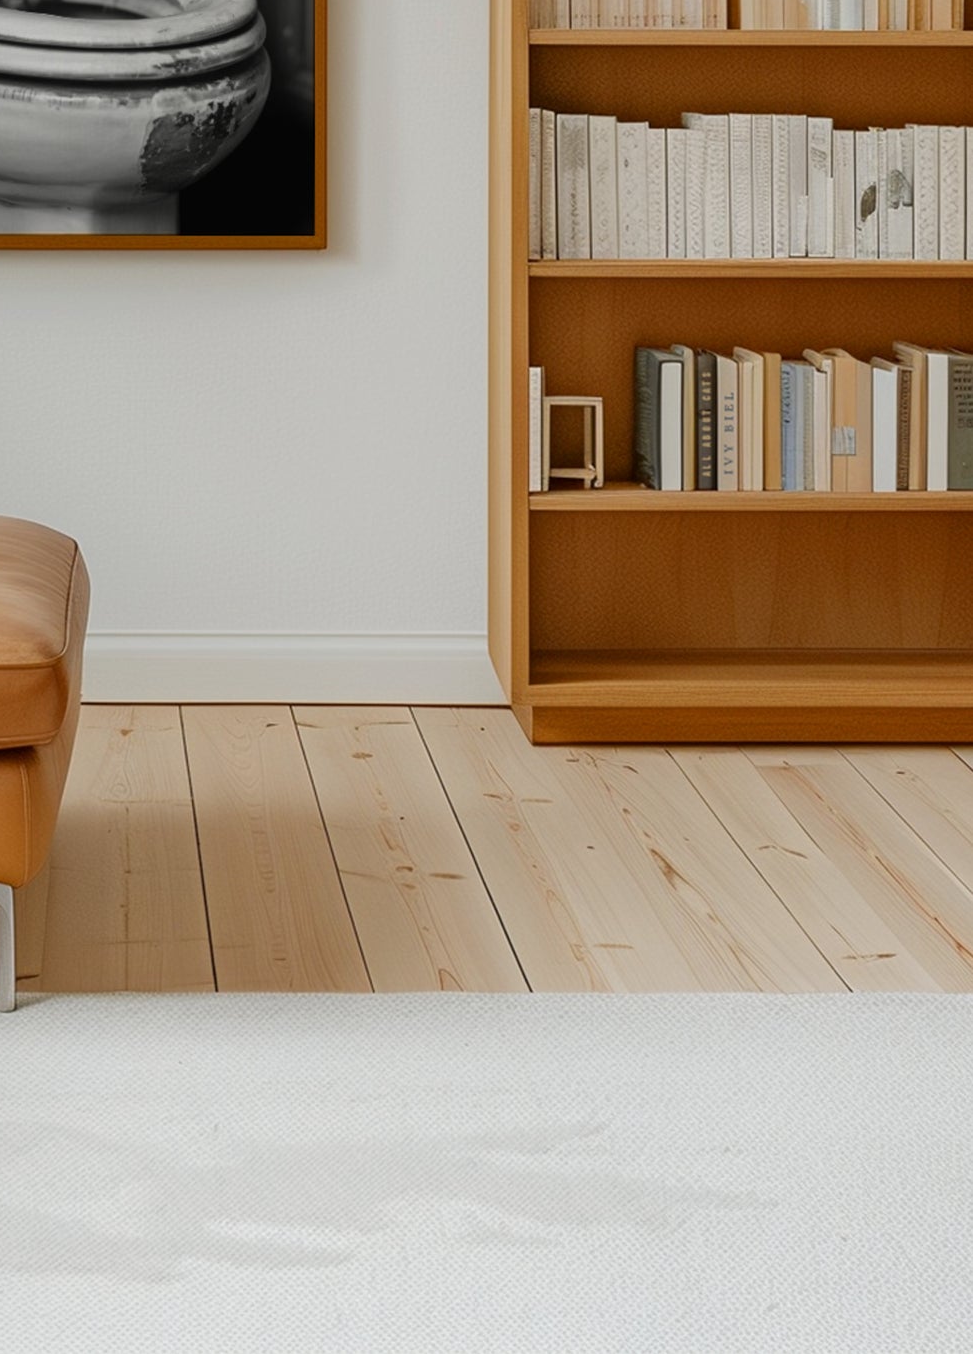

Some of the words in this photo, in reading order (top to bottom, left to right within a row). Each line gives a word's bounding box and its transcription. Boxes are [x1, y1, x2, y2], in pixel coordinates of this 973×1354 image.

[701, 371, 712, 402] CATS
[723, 391, 735, 433] BIEL
[701, 409, 712, 448] ABOUT
[702, 455, 712, 478] ALL
[723, 444, 735, 476] IVY
